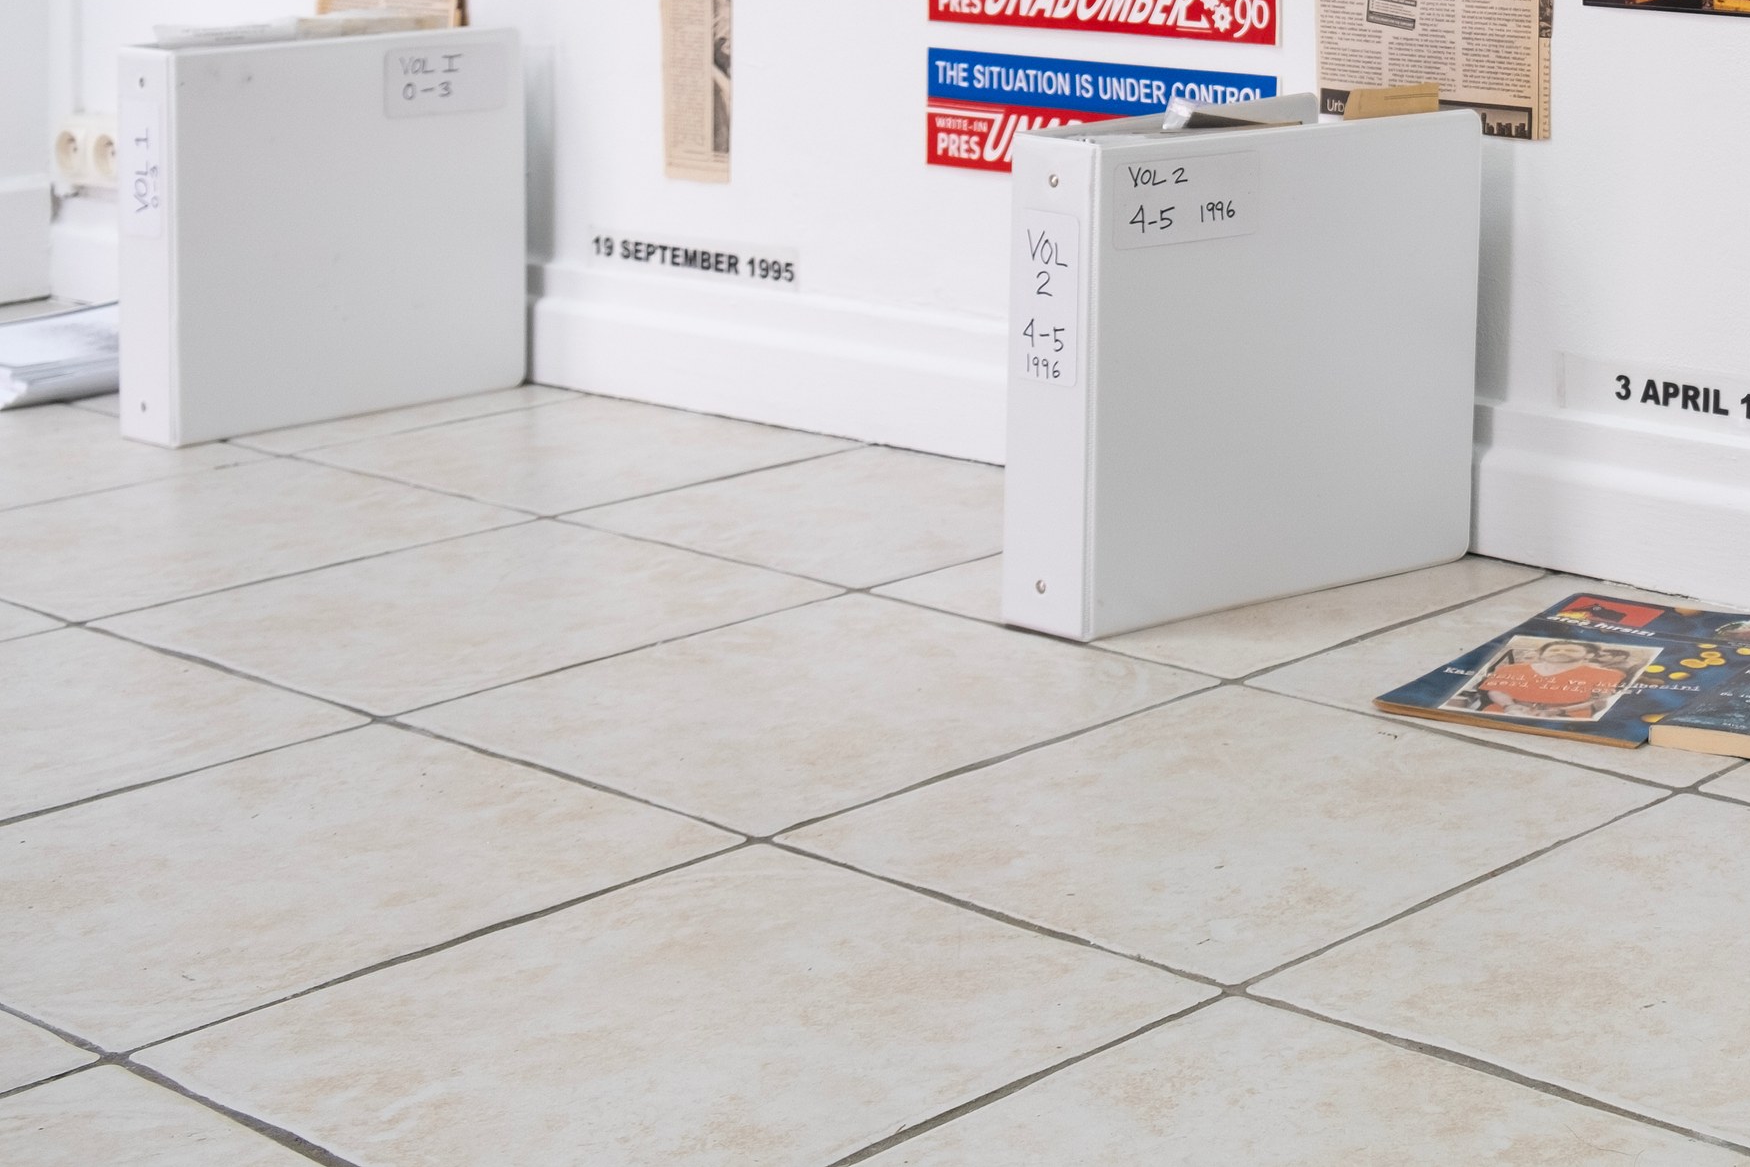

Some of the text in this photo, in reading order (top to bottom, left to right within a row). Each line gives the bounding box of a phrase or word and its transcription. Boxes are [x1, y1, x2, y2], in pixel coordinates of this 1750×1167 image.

[399, 56, 435, 76] VOL
[935, 60, 969, 87] THE
[973, 64, 1071, 97] SITUATION
[1076, 73, 1094, 98] IS
[1099, 76, 1165, 105] UNDER
[1128, 166, 1188, 187] VOL 2
[1129, 200, 1236, 233] 4-5 1996
[592, 235, 794, 283] 19 SEPTEMBER 1995
[1027, 229, 1068, 267] VOL
[1036, 271, 1052, 297] 2
[1022, 318, 1065, 352] 4-5
[1026, 353, 1061, 379] 1996
[1615, 374, 1631, 401] 3
[1640, 379, 1729, 416] APRIL
